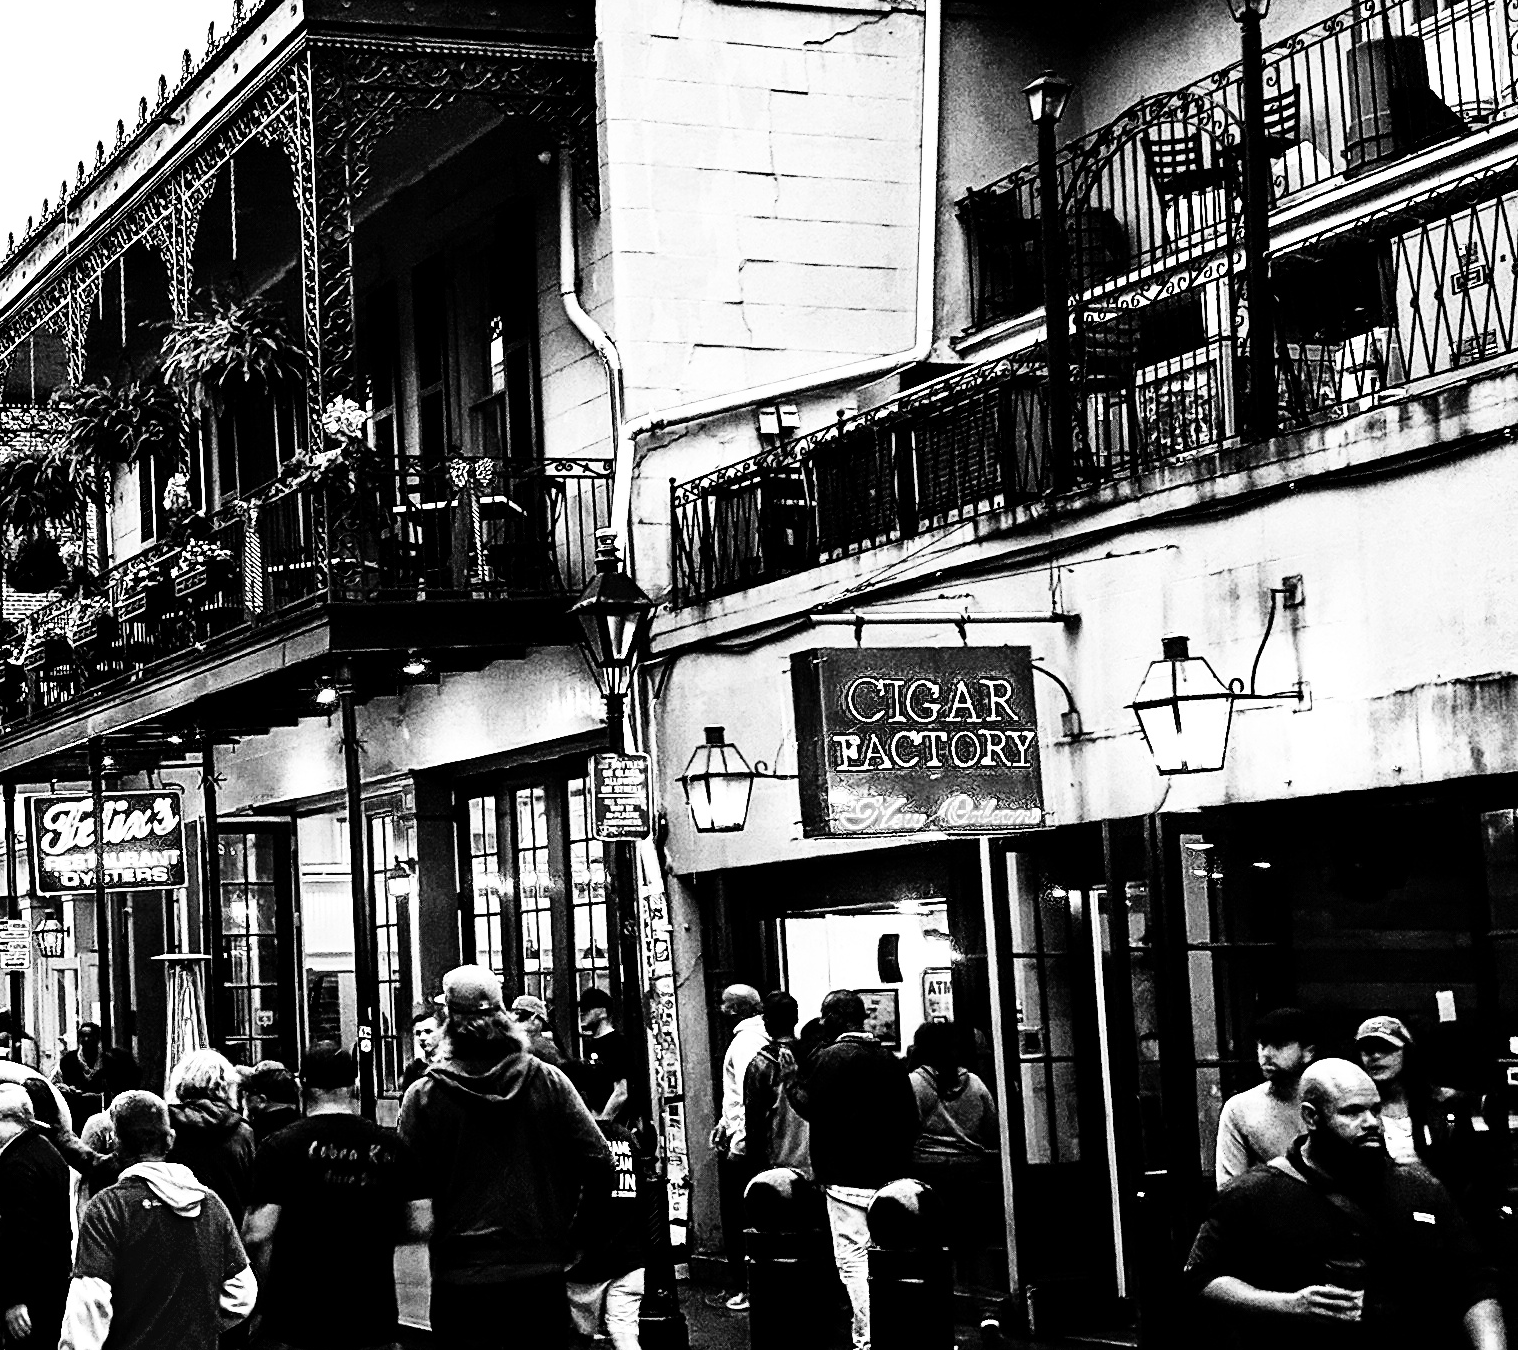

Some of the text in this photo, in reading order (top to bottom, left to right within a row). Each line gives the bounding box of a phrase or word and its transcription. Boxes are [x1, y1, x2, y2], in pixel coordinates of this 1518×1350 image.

[848, 678, 1019, 723] CIGAR
[833, 729, 1036, 771] FACTORY
[45, 850, 181, 872] RESTURANT
